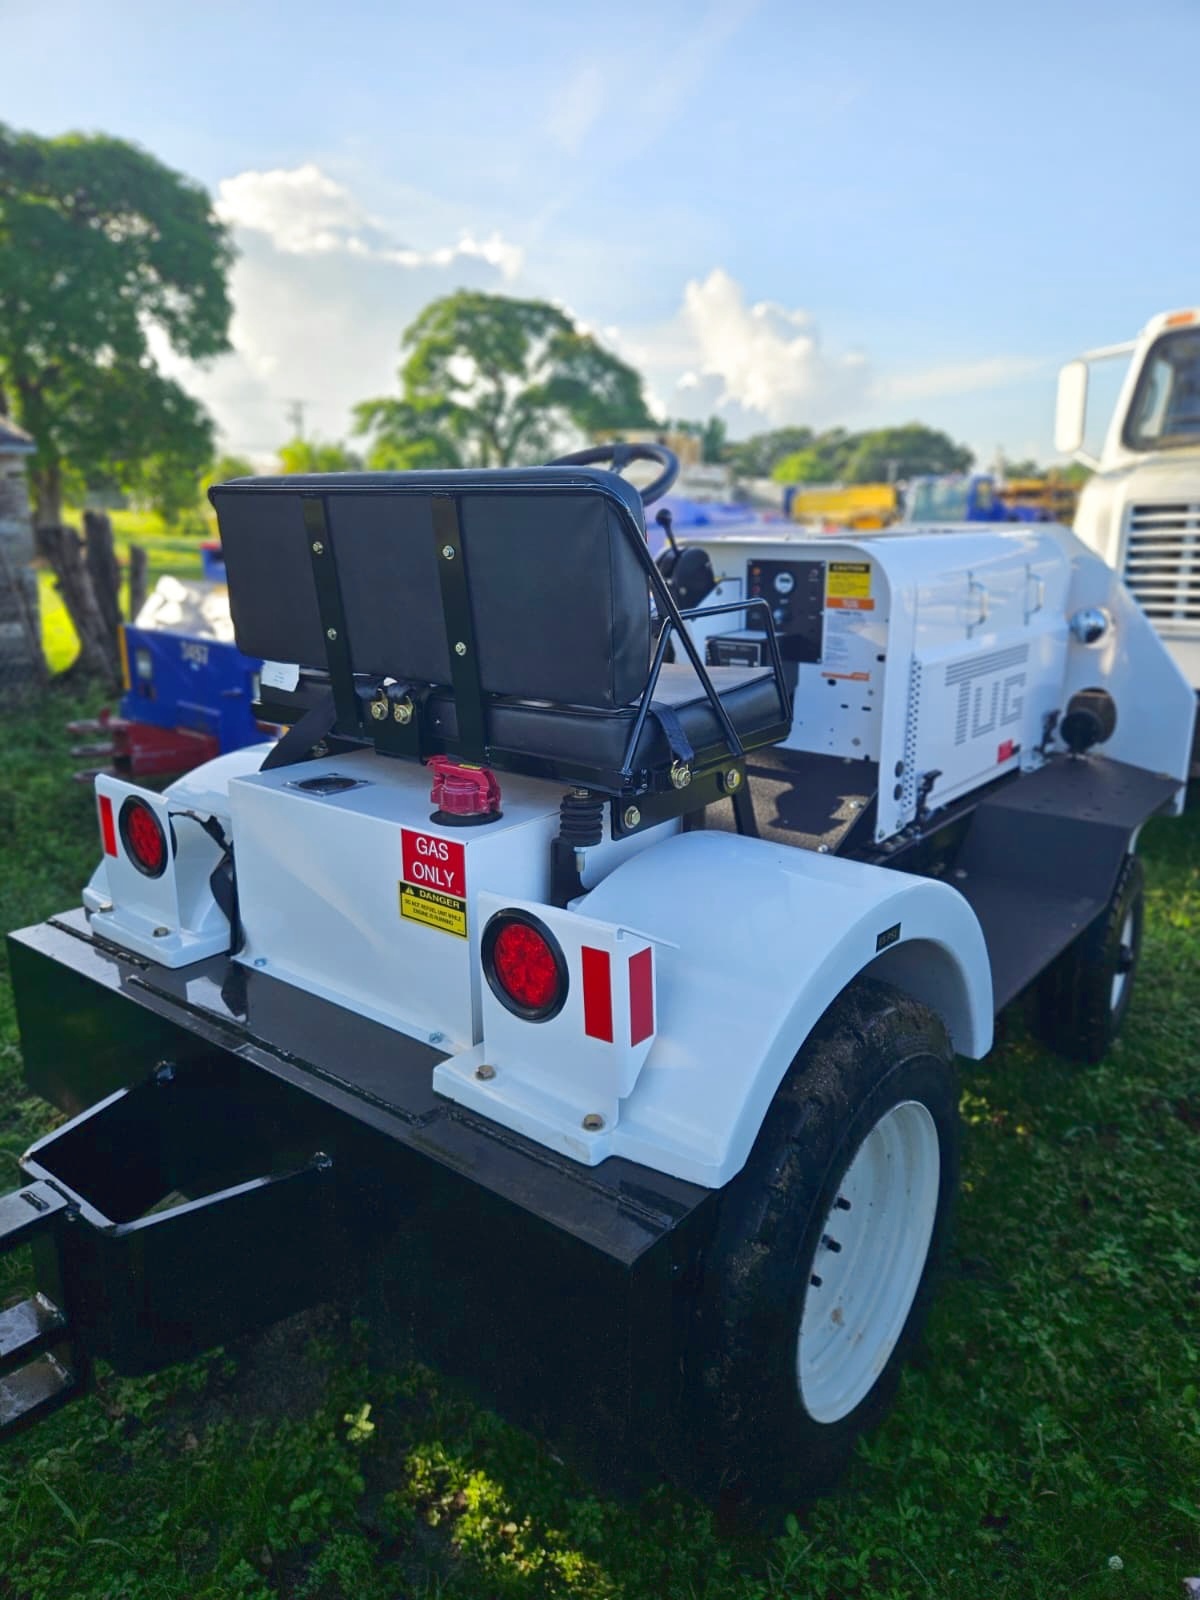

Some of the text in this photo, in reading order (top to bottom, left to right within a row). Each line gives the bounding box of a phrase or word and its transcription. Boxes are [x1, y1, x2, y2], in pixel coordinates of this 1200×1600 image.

[944, 643, 1030, 746] TUG
[416, 837, 449, 861] GAS
[412, 861, 455, 888] ONLY
[419, 890, 460, 909] DANGER
